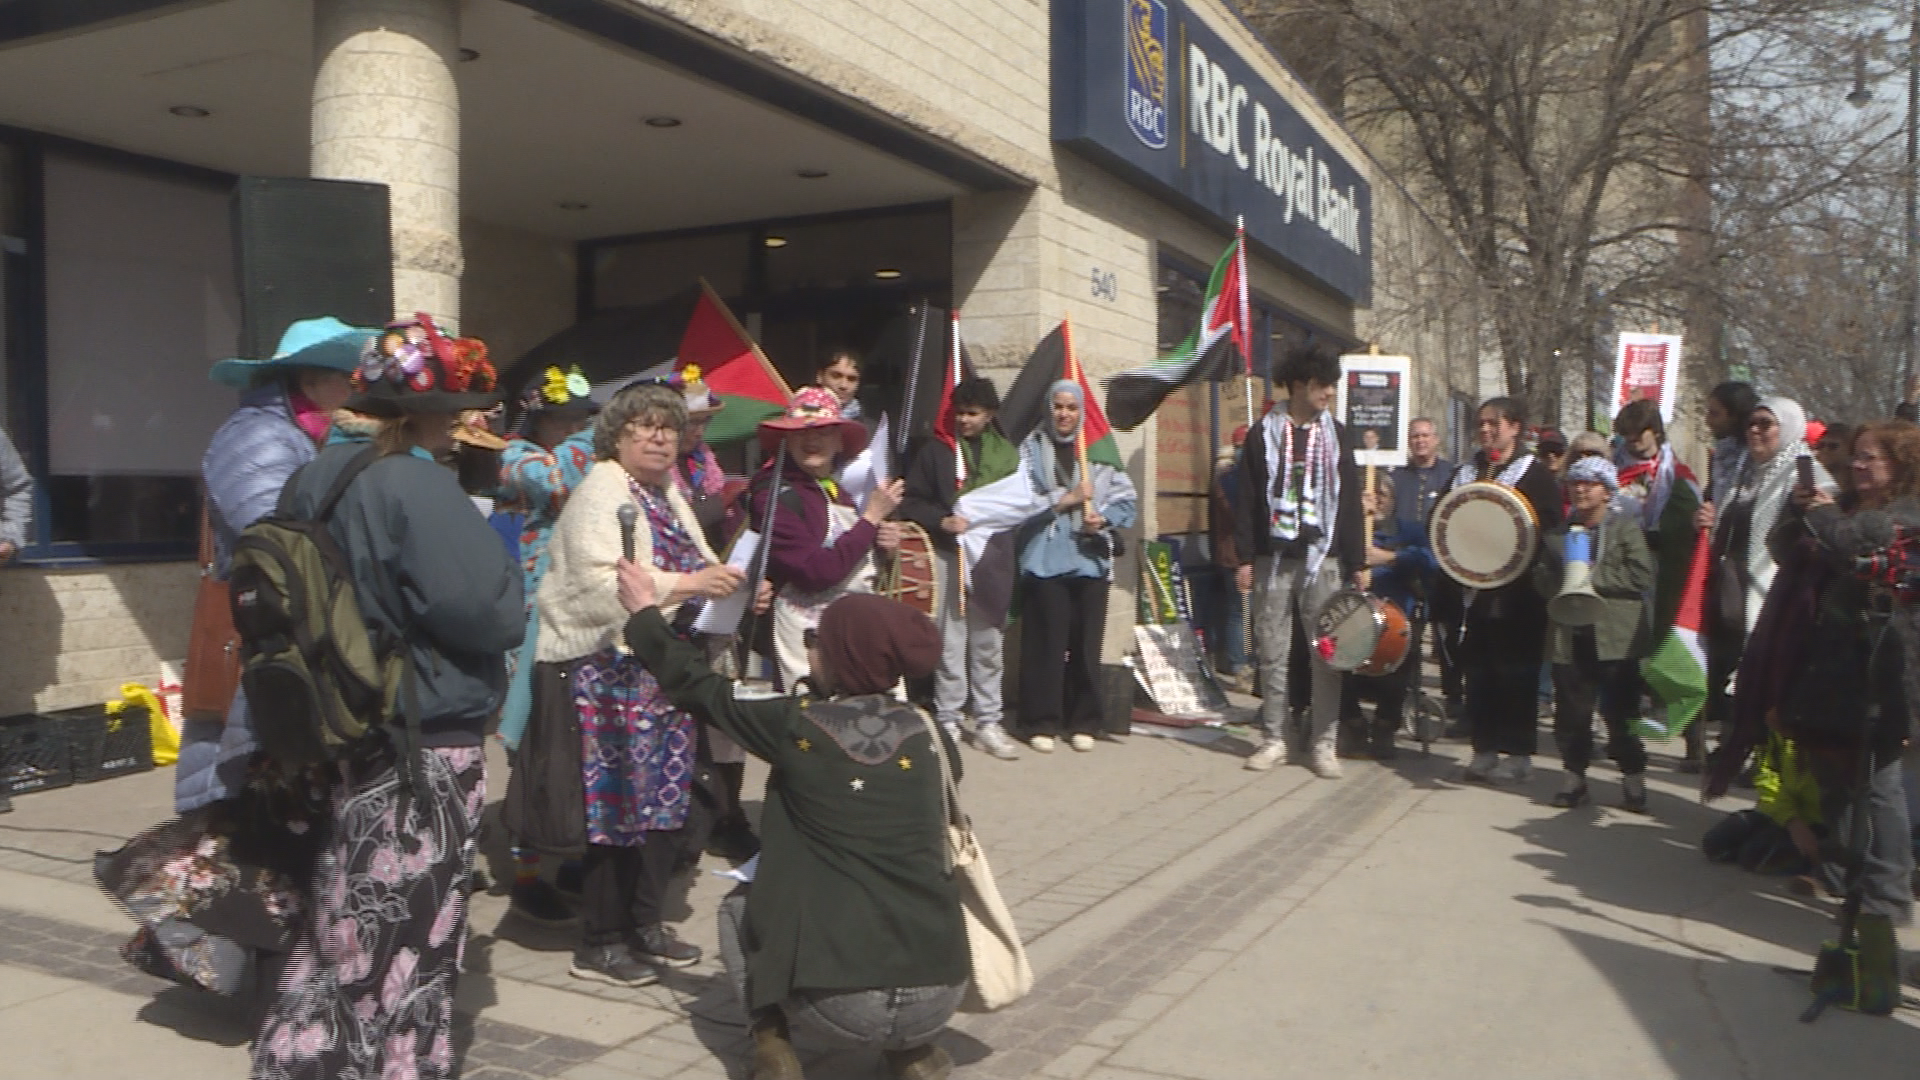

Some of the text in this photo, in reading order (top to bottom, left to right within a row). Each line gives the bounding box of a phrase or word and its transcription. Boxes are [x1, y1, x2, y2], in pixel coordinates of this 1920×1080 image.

[1130, 88, 1164, 140] RBC
[1189, 43, 1361, 255] RBC Royal Bank
[1091, 267, 1117, 302] 540
